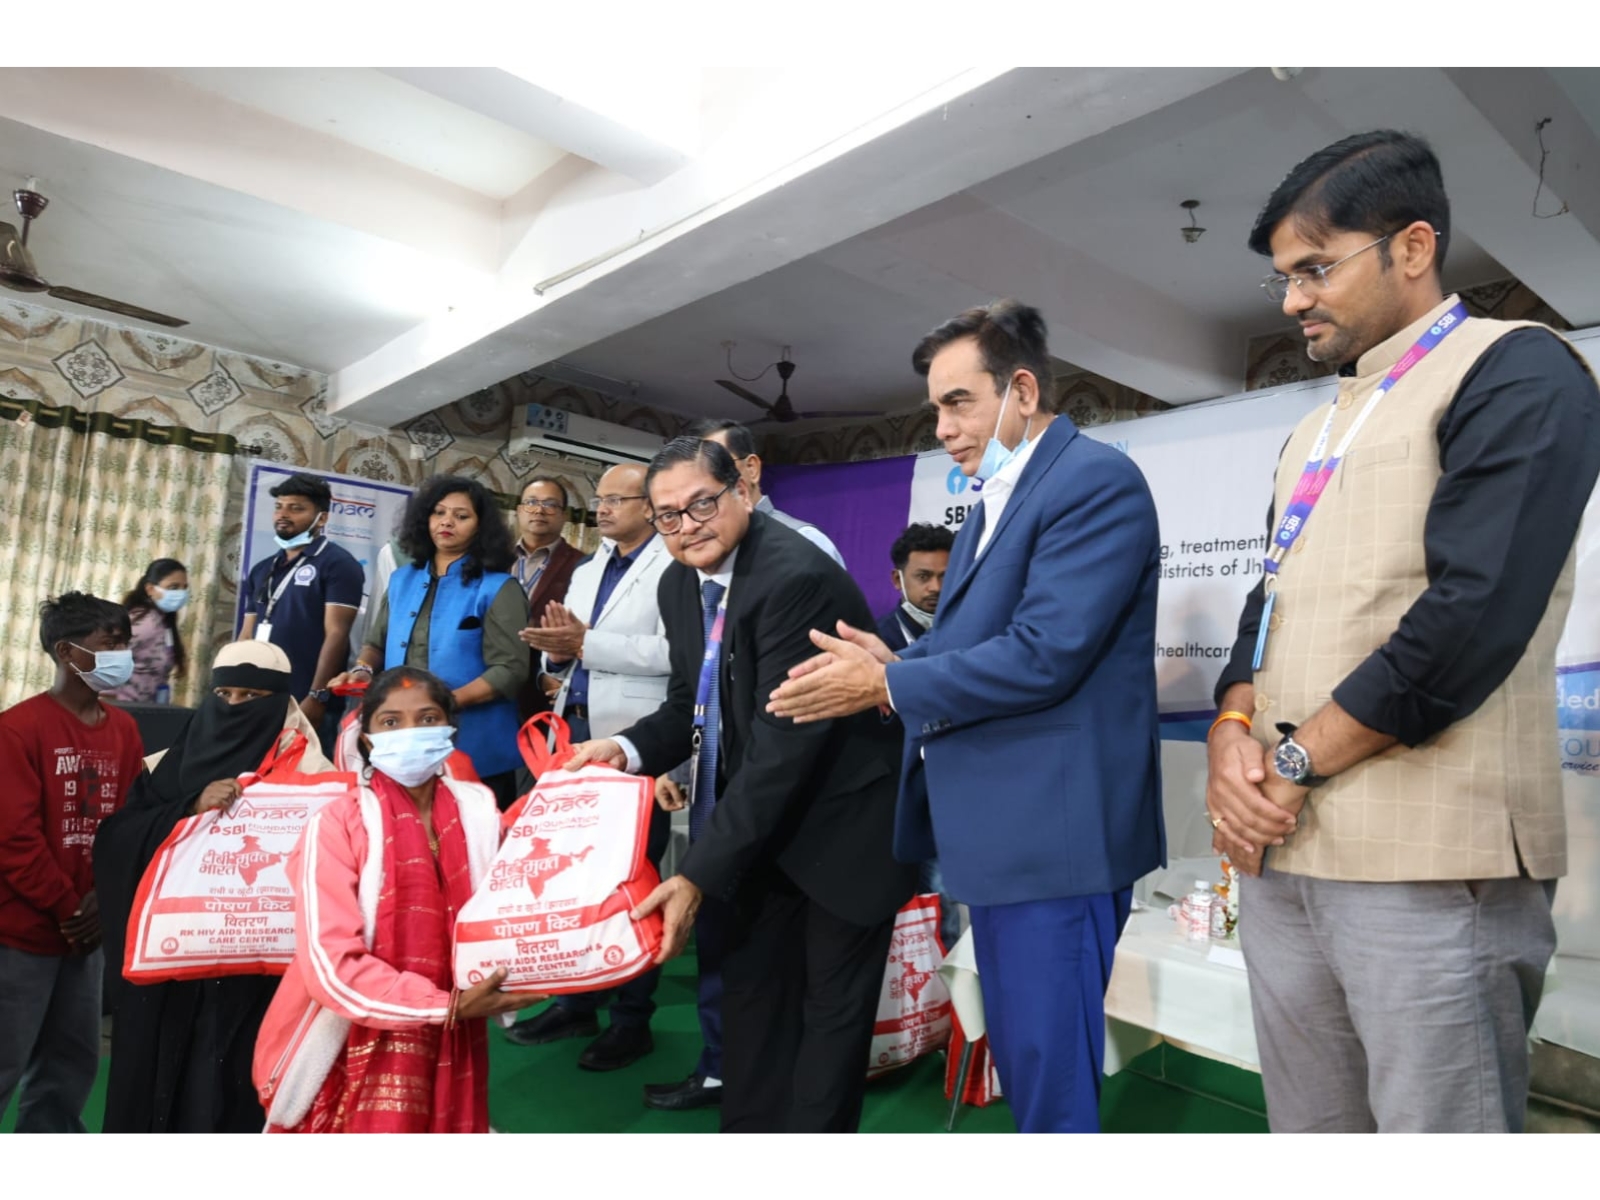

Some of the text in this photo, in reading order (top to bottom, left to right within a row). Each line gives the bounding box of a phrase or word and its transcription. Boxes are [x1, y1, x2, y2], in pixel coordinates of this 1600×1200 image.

[1437, 312, 1457, 329] SBI
[1284, 514, 1301, 532] SBI
[1180, 535, 1265, 554] treatment
[1220, 558, 1238, 576] of
[222, 824, 246, 836] SBI
[248, 823, 304, 832] FOUNDATIO
[204, 897, 291, 912] पोषण किट
[224, 914, 269, 927] वितरण
[493, 913, 581, 938] पोषण किट
[180, 929, 194, 937] RK
[218, 928, 240, 936] AIDS
[240, 936, 279, 944] CENTRE
[515, 939, 560, 956] वितरण
[495, 959, 512, 967] HIV
[514, 957, 537, 965] AIDS
[540, 946, 593, 963] RESEARCH
[509, 960, 577, 974] CARE CENTRE
